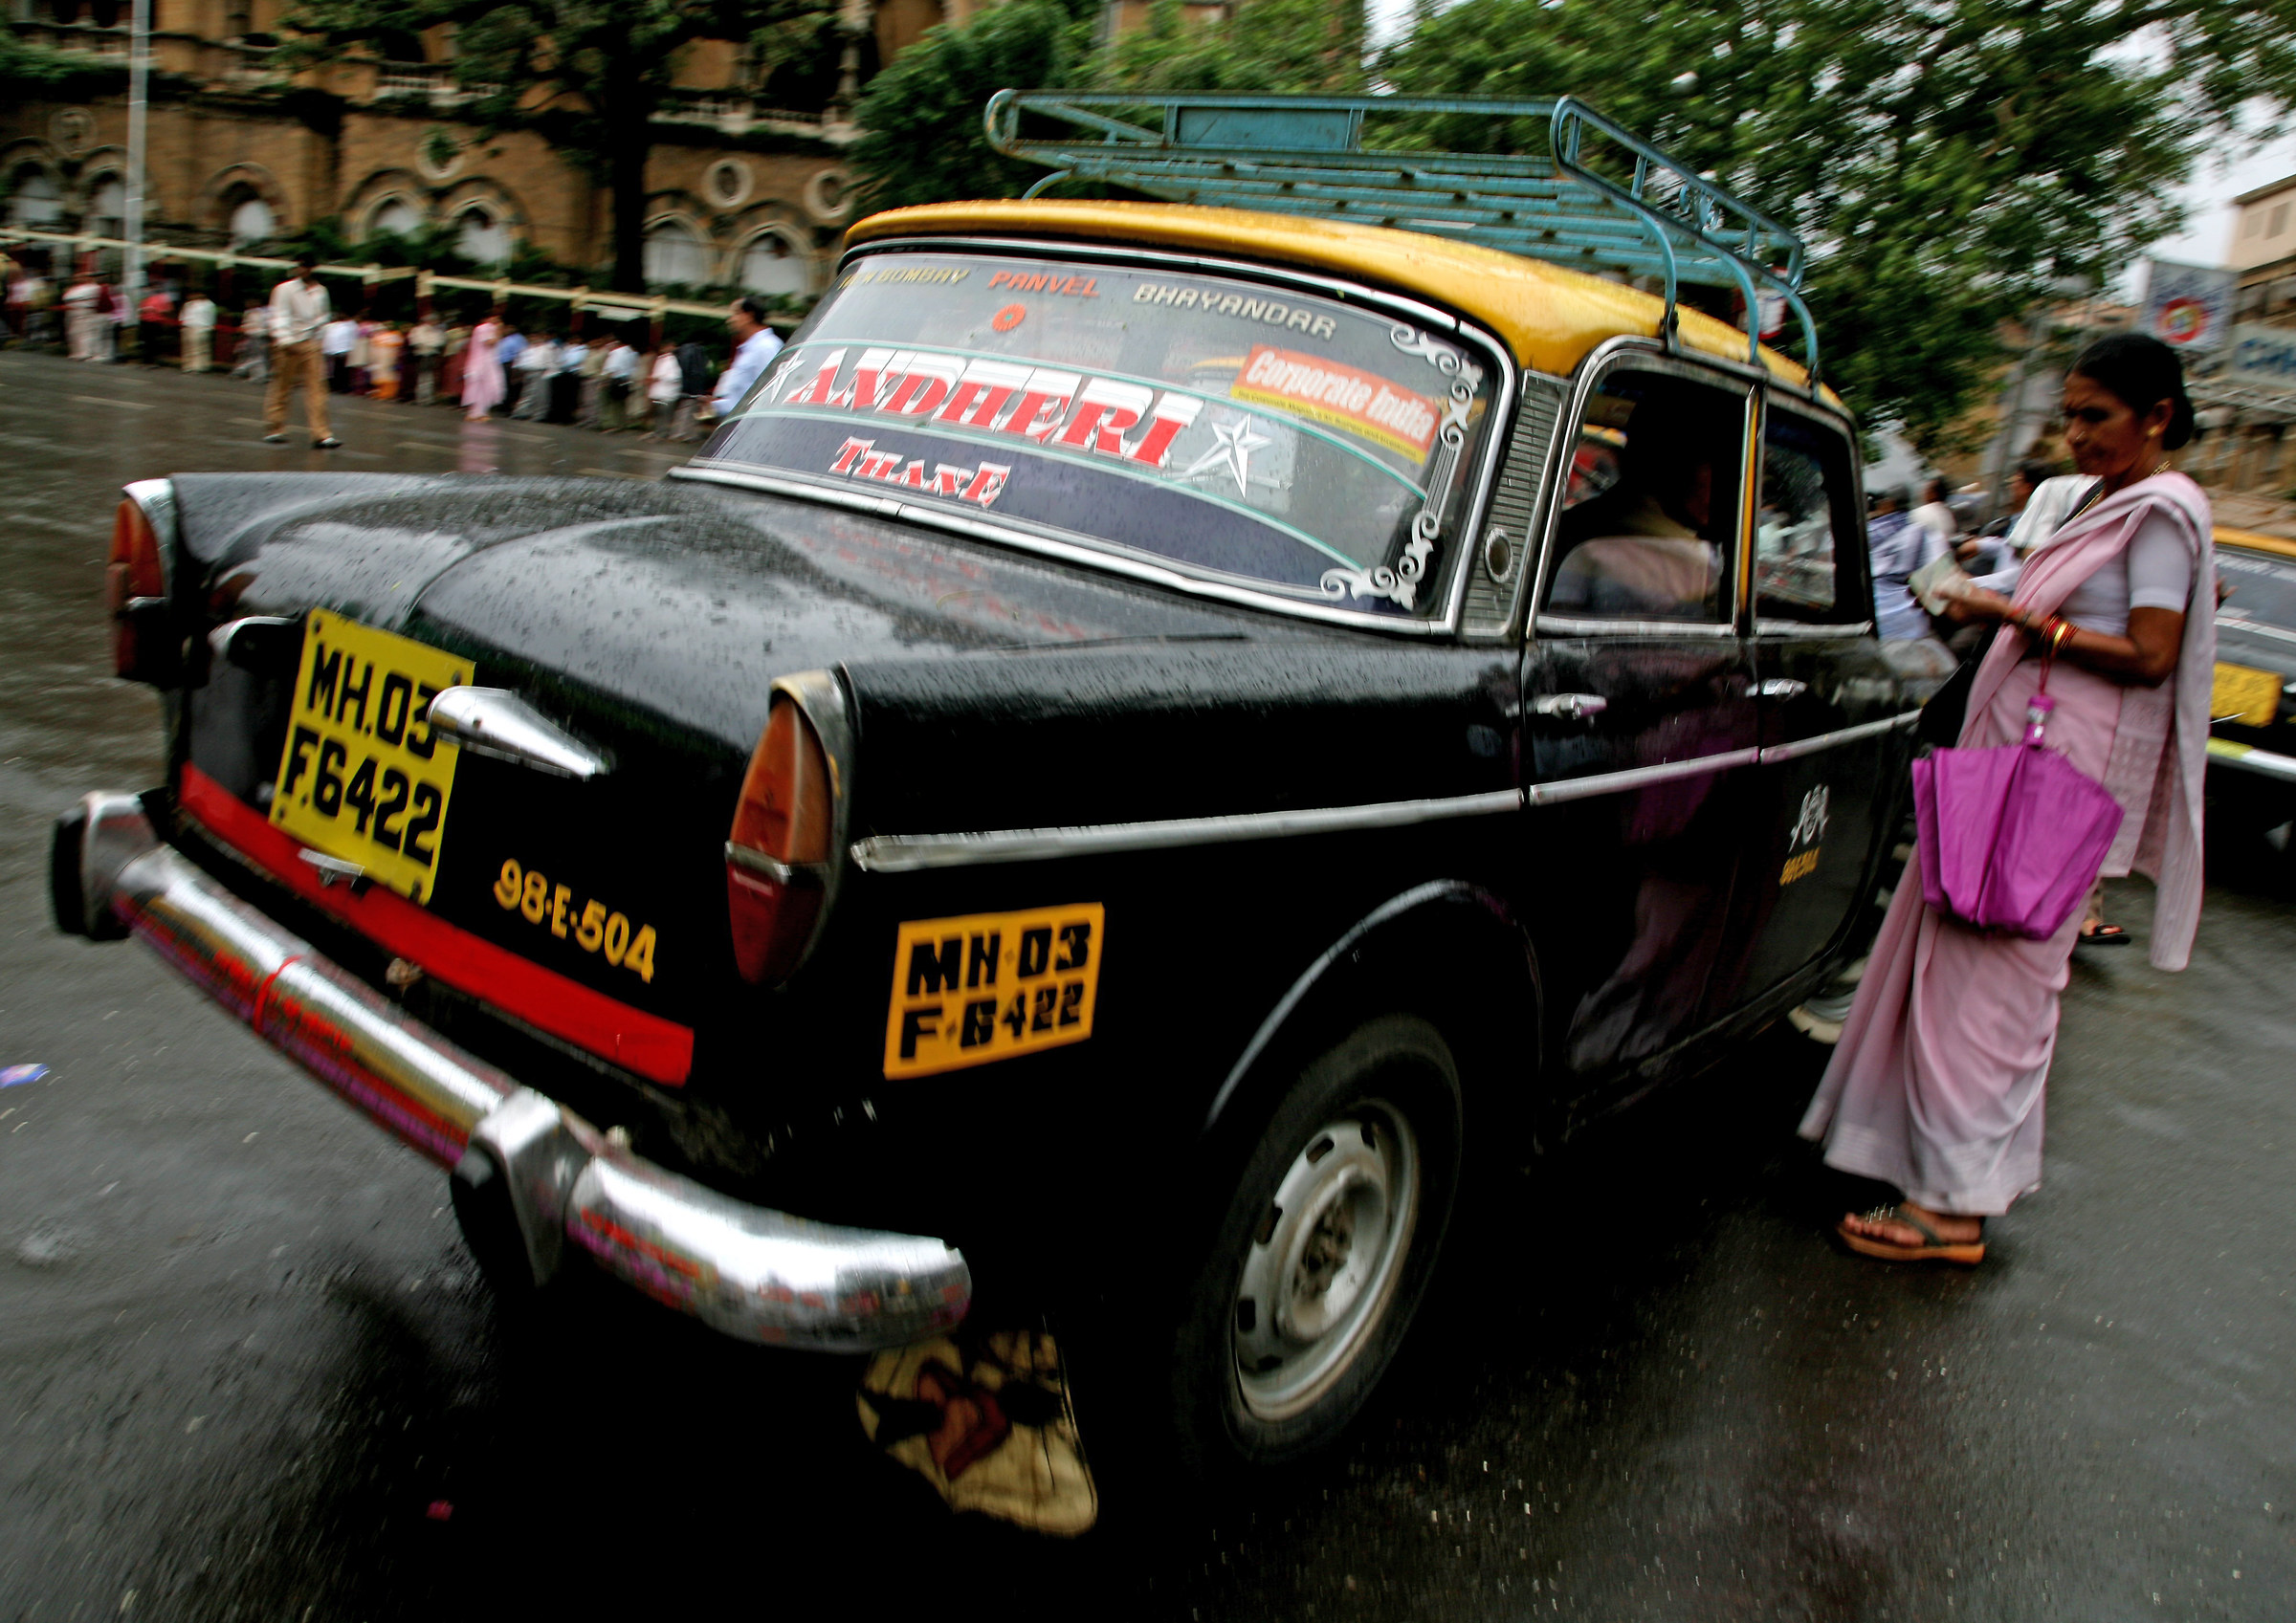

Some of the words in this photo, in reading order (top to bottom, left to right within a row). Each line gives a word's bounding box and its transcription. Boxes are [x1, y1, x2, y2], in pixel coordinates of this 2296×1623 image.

[875, 267, 970, 285] BOMBAY
[988, 270, 1099, 297] PANVEL
[1133, 283, 1336, 340] BHAYANDAR
[783, 347, 1204, 467] ANDHERI
[1247, 350, 1372, 413] Corporate
[1366, 384, 1434, 444] India
[828, 437, 1012, 508] THANE
